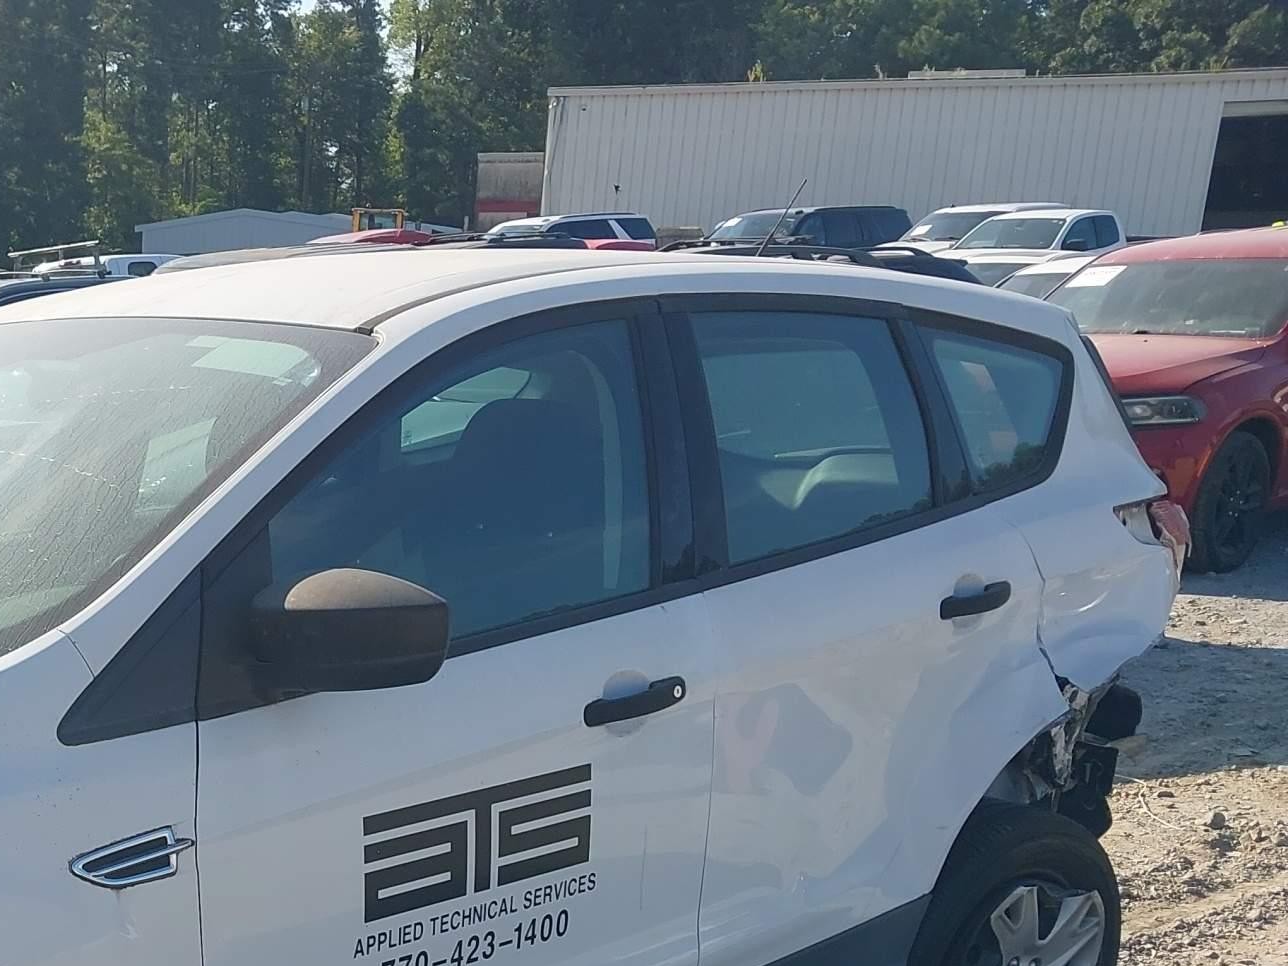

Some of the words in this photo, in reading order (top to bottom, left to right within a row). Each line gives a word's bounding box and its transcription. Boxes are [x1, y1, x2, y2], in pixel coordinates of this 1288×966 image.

[353, 922, 424, 959] APPLIED
[429, 895, 518, 937] TECHNICAL
[523, 872, 597, 910] SERVICES
